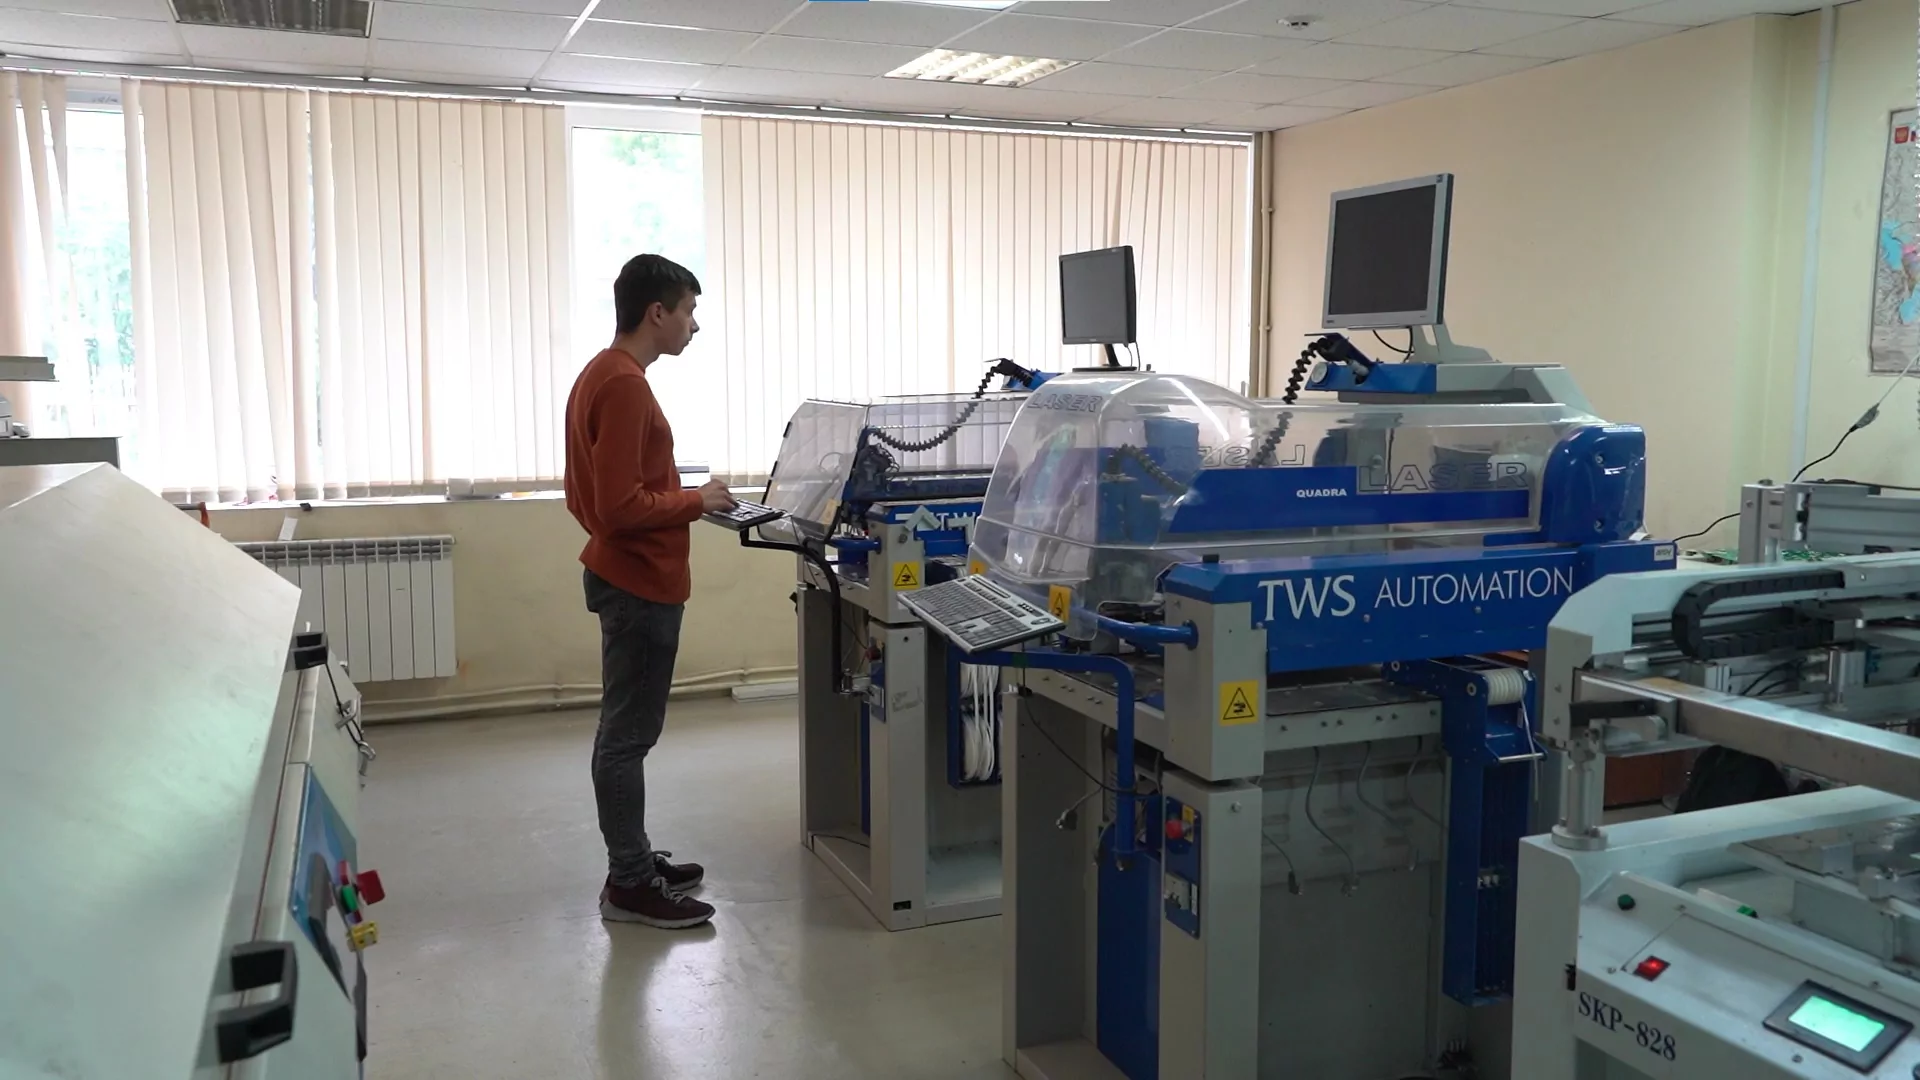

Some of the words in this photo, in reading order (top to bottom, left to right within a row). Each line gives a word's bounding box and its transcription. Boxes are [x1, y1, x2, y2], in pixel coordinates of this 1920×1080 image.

[1027, 393, 1103, 412] LASER
[1358, 462, 1529, 492] LASER
[1296, 488, 1347, 498] QUADRA
[1257, 574, 1356, 621] TWS
[1374, 566, 1573, 608] AUTOMATION
[1578, 991, 1676, 1062] SKP-828
